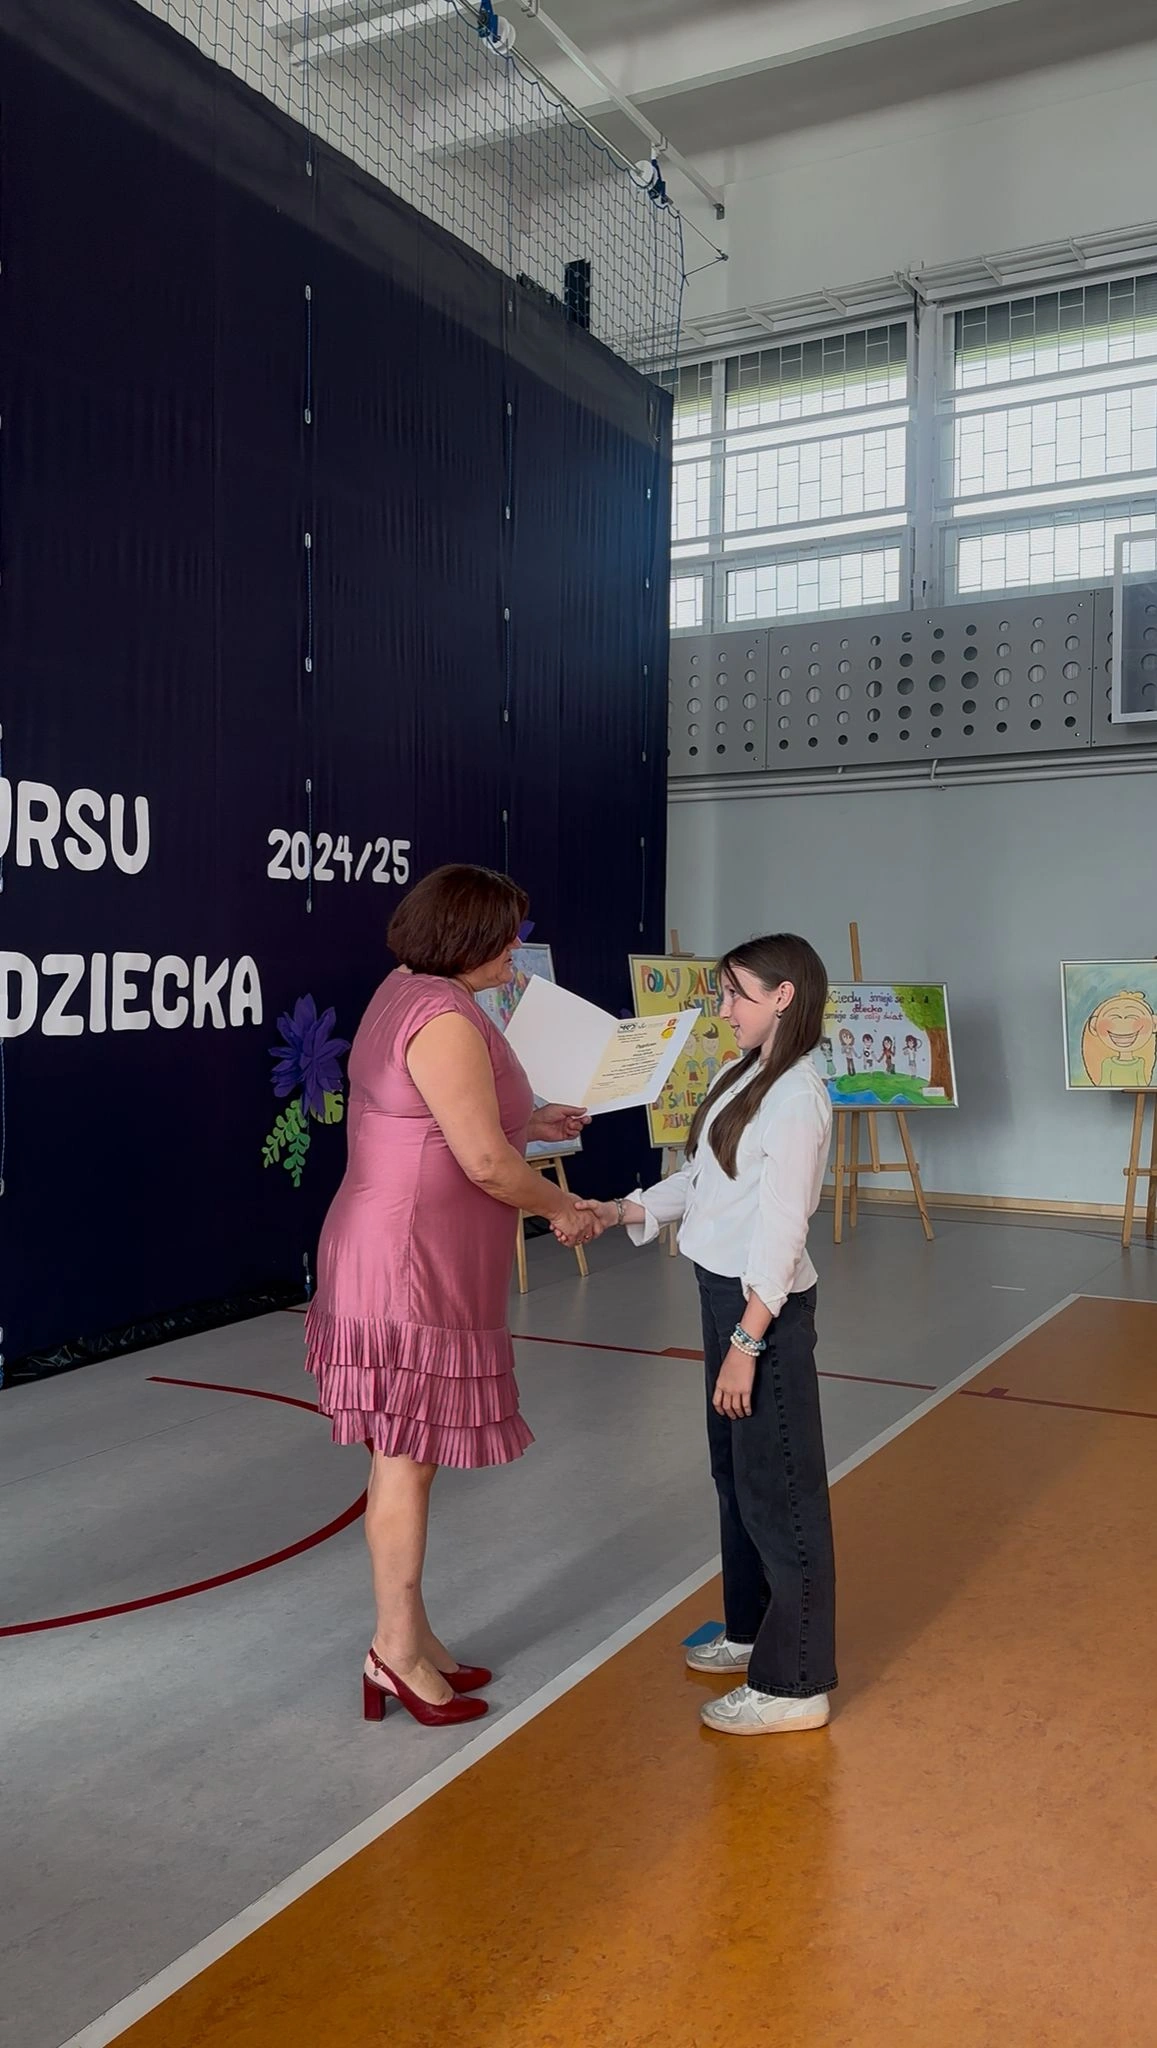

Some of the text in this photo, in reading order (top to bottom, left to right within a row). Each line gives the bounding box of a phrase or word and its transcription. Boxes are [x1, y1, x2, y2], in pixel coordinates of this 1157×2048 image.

[267, 828, 411, 885] 2024/25
[0, 950, 263, 1038] DZIECKA
[640, 965, 717, 999] PODAJ DALE
[826, 990, 861, 1006] Kiedy
